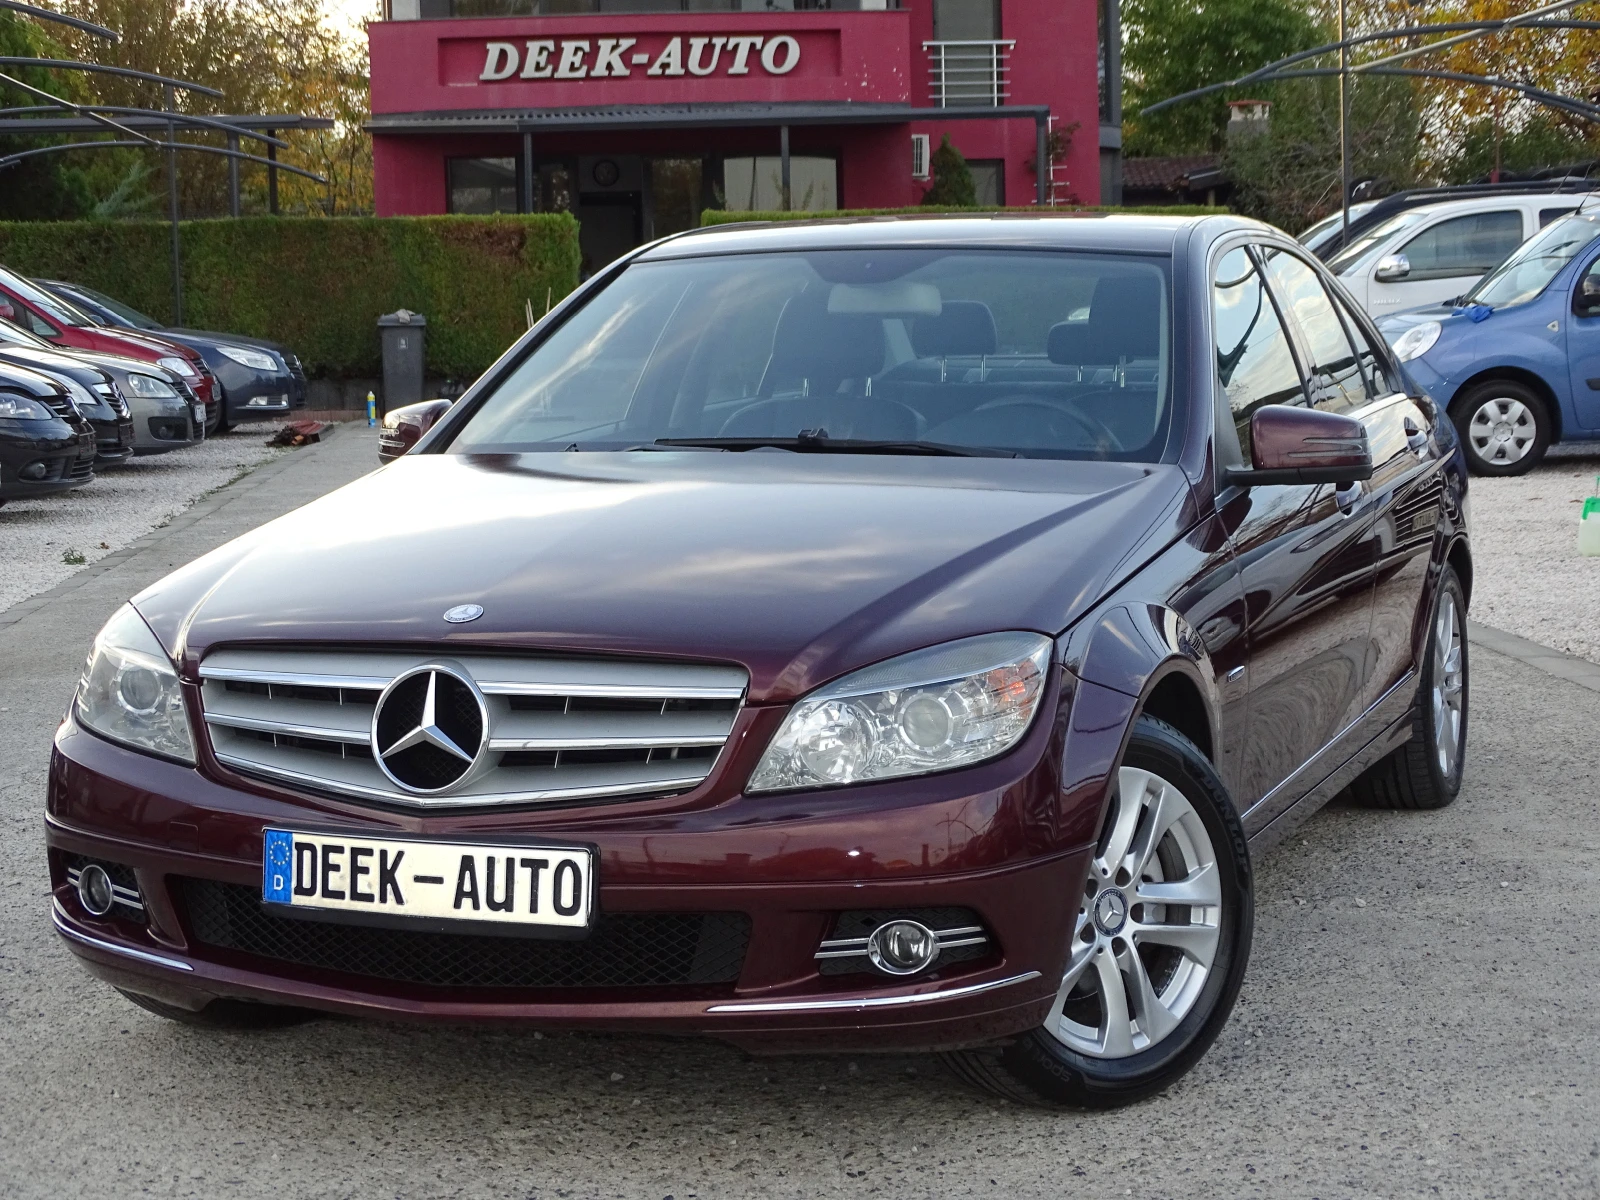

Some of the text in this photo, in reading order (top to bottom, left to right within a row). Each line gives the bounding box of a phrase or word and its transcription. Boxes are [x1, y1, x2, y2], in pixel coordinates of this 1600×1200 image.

[480, 35, 801, 81] DEEK-AUTO
[274, 875, 284, 890] D
[294, 842, 582, 917] DEEK-AUTO
